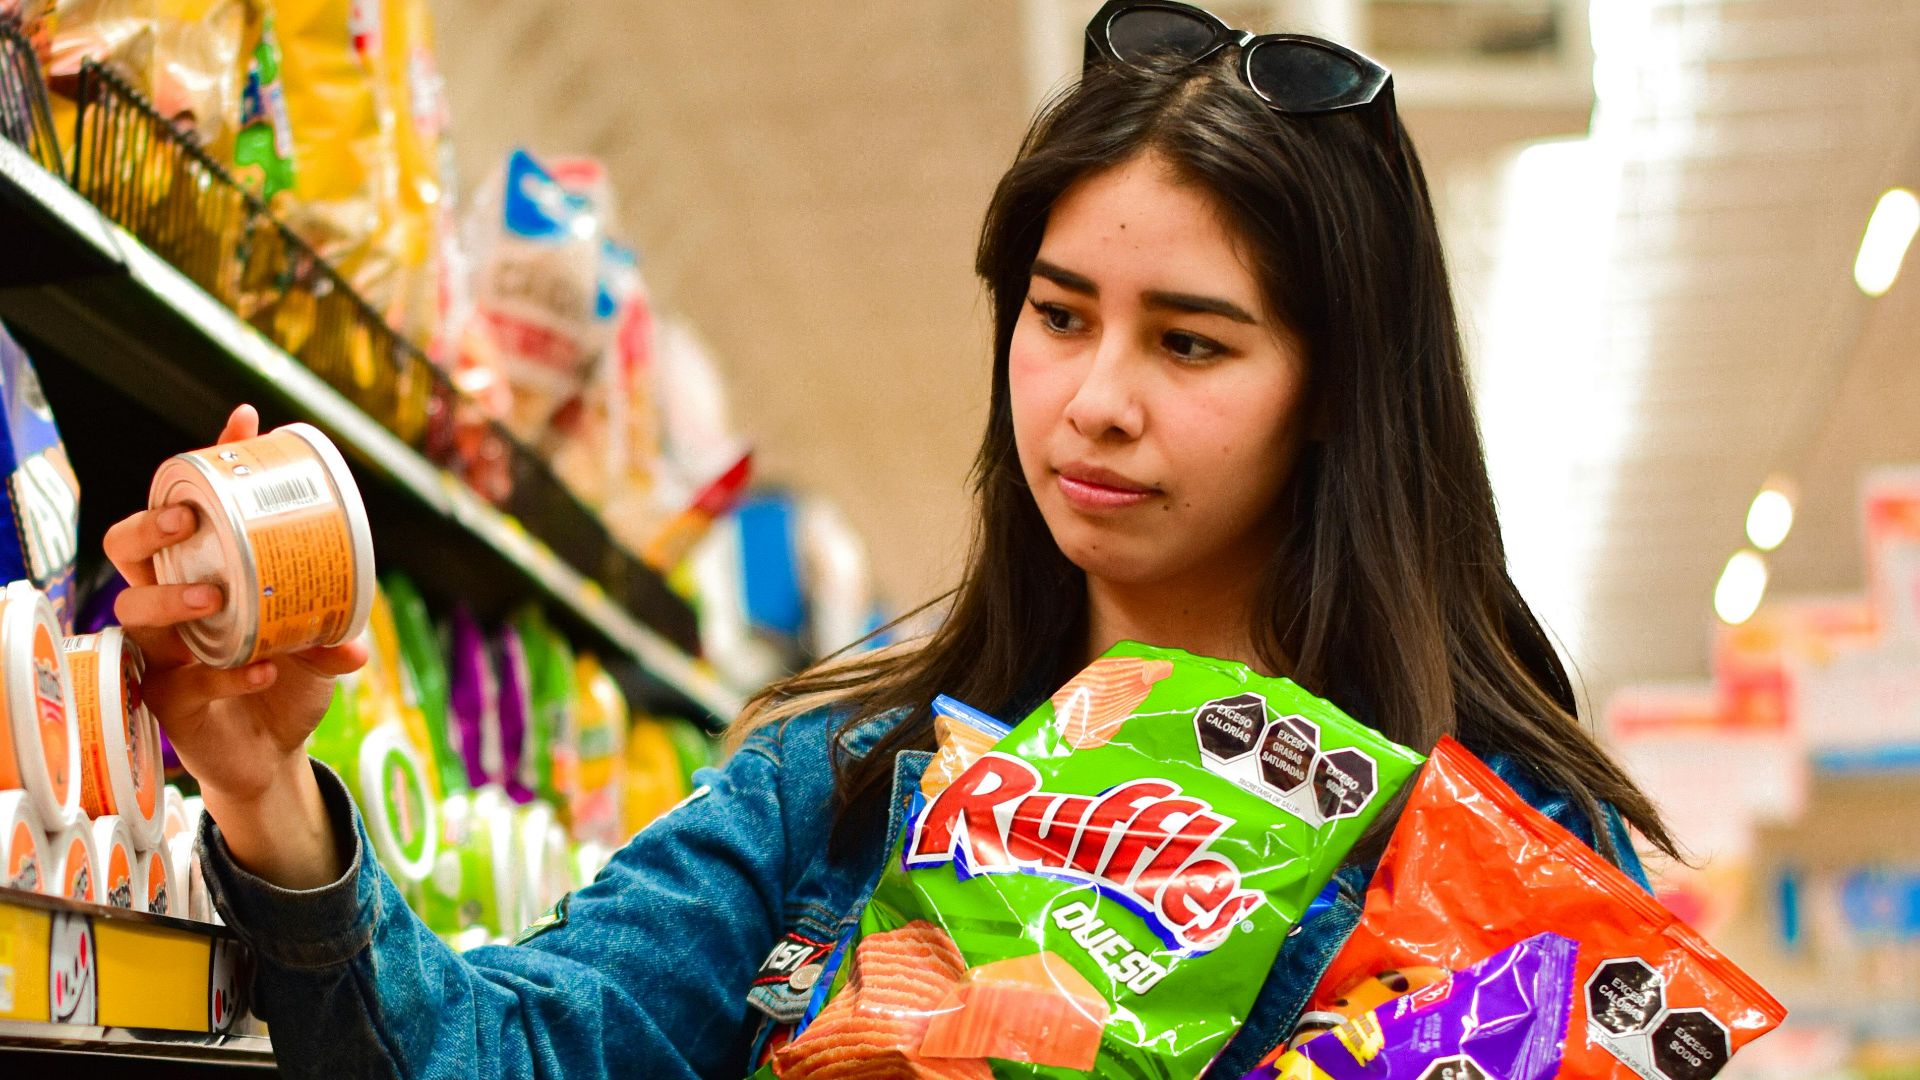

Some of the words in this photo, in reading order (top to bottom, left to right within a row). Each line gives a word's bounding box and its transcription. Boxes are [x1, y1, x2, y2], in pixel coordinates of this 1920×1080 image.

[1205, 713, 1252, 744] CALORÍAS
[1216, 704, 1253, 729] EXCESO
[1272, 741, 1303, 765] GRASAS
[1277, 729, 1308, 752] EXCESO
[1261, 750, 1305, 782] SATURADAS
[1325, 765, 1360, 791] EXCESO
[1052, 901, 1170, 995] QUESO
[1611, 977, 1648, 1008] EXCESO
[1669, 1040, 1702, 1068] SODIO
[1674, 1027, 1714, 1060] EXCESO
